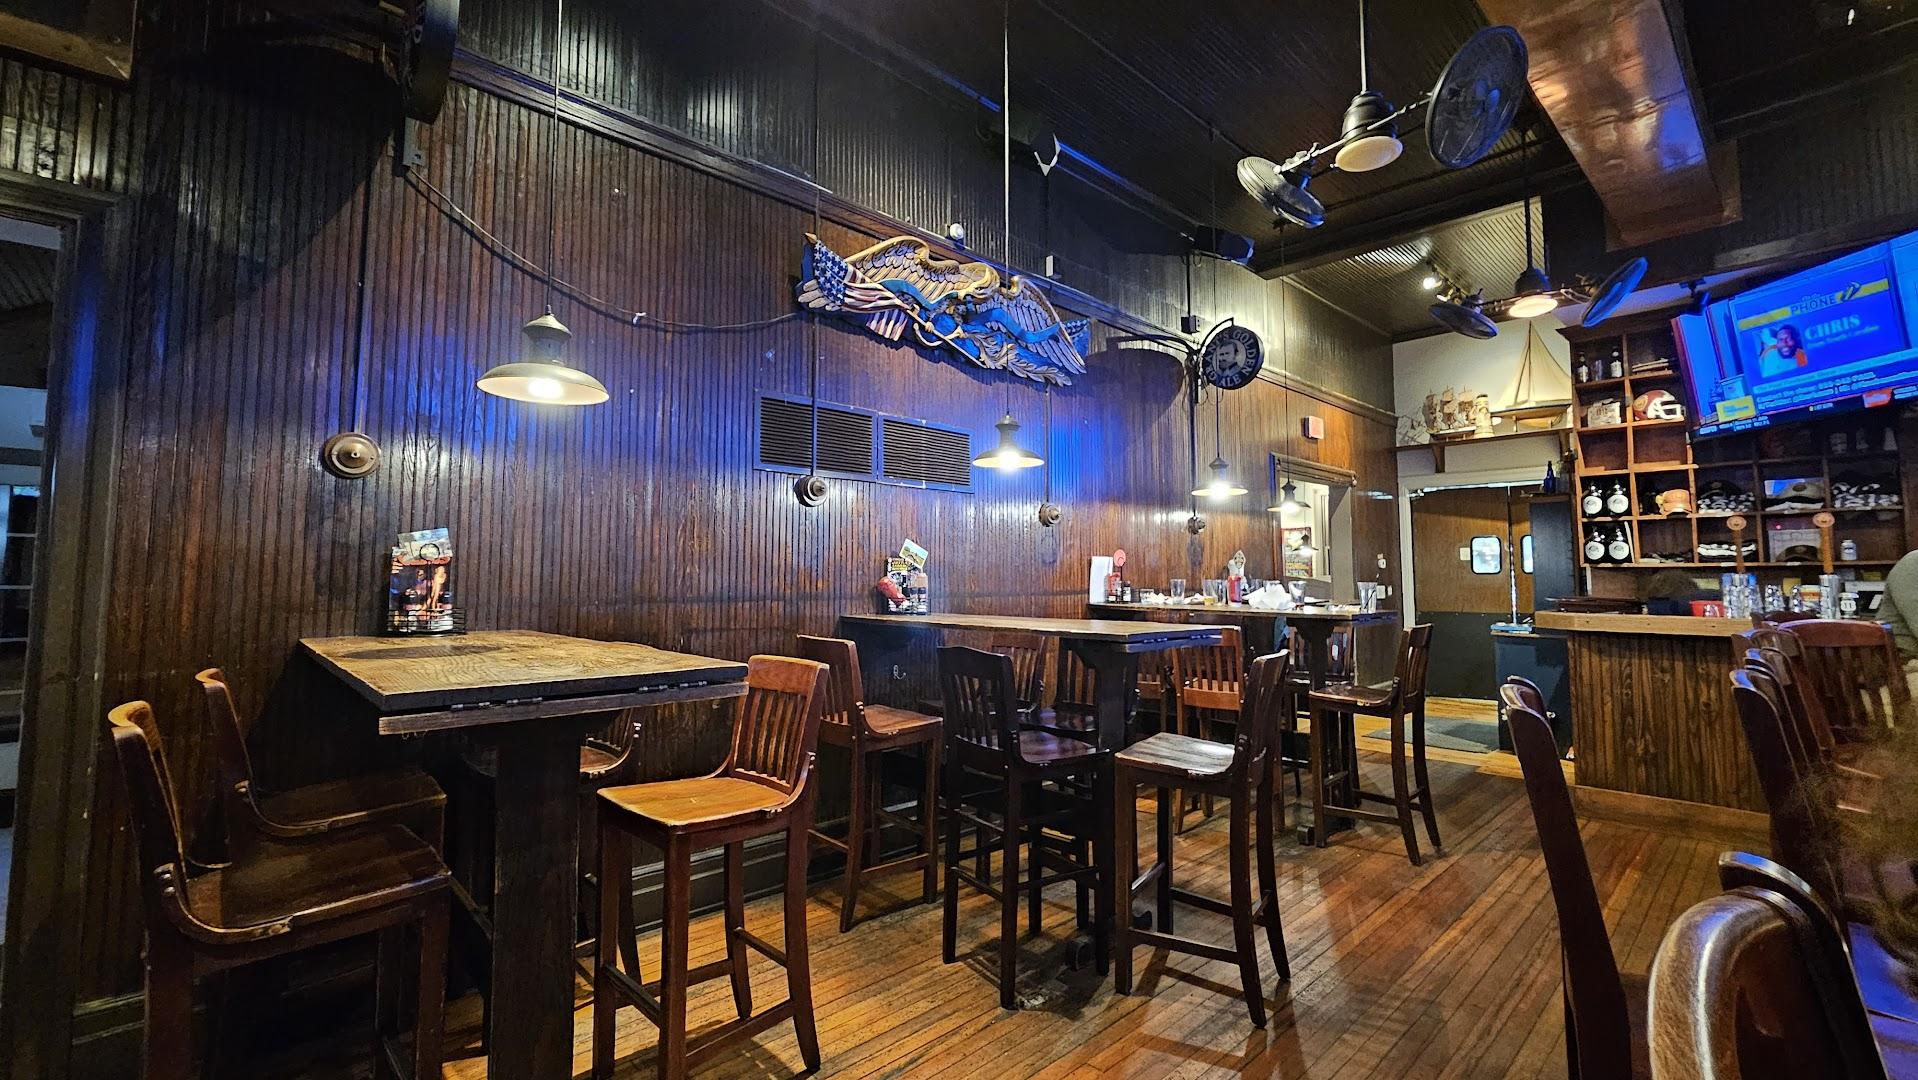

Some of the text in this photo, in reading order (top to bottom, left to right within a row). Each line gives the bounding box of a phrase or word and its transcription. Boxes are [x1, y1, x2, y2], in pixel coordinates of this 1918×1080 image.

[1790, 294, 1836, 315] PHONE
[1804, 314, 1861, 340] CHRIS
[1232, 329, 1257, 376] GOLDEN
[1219, 374, 1242, 387] ALE
